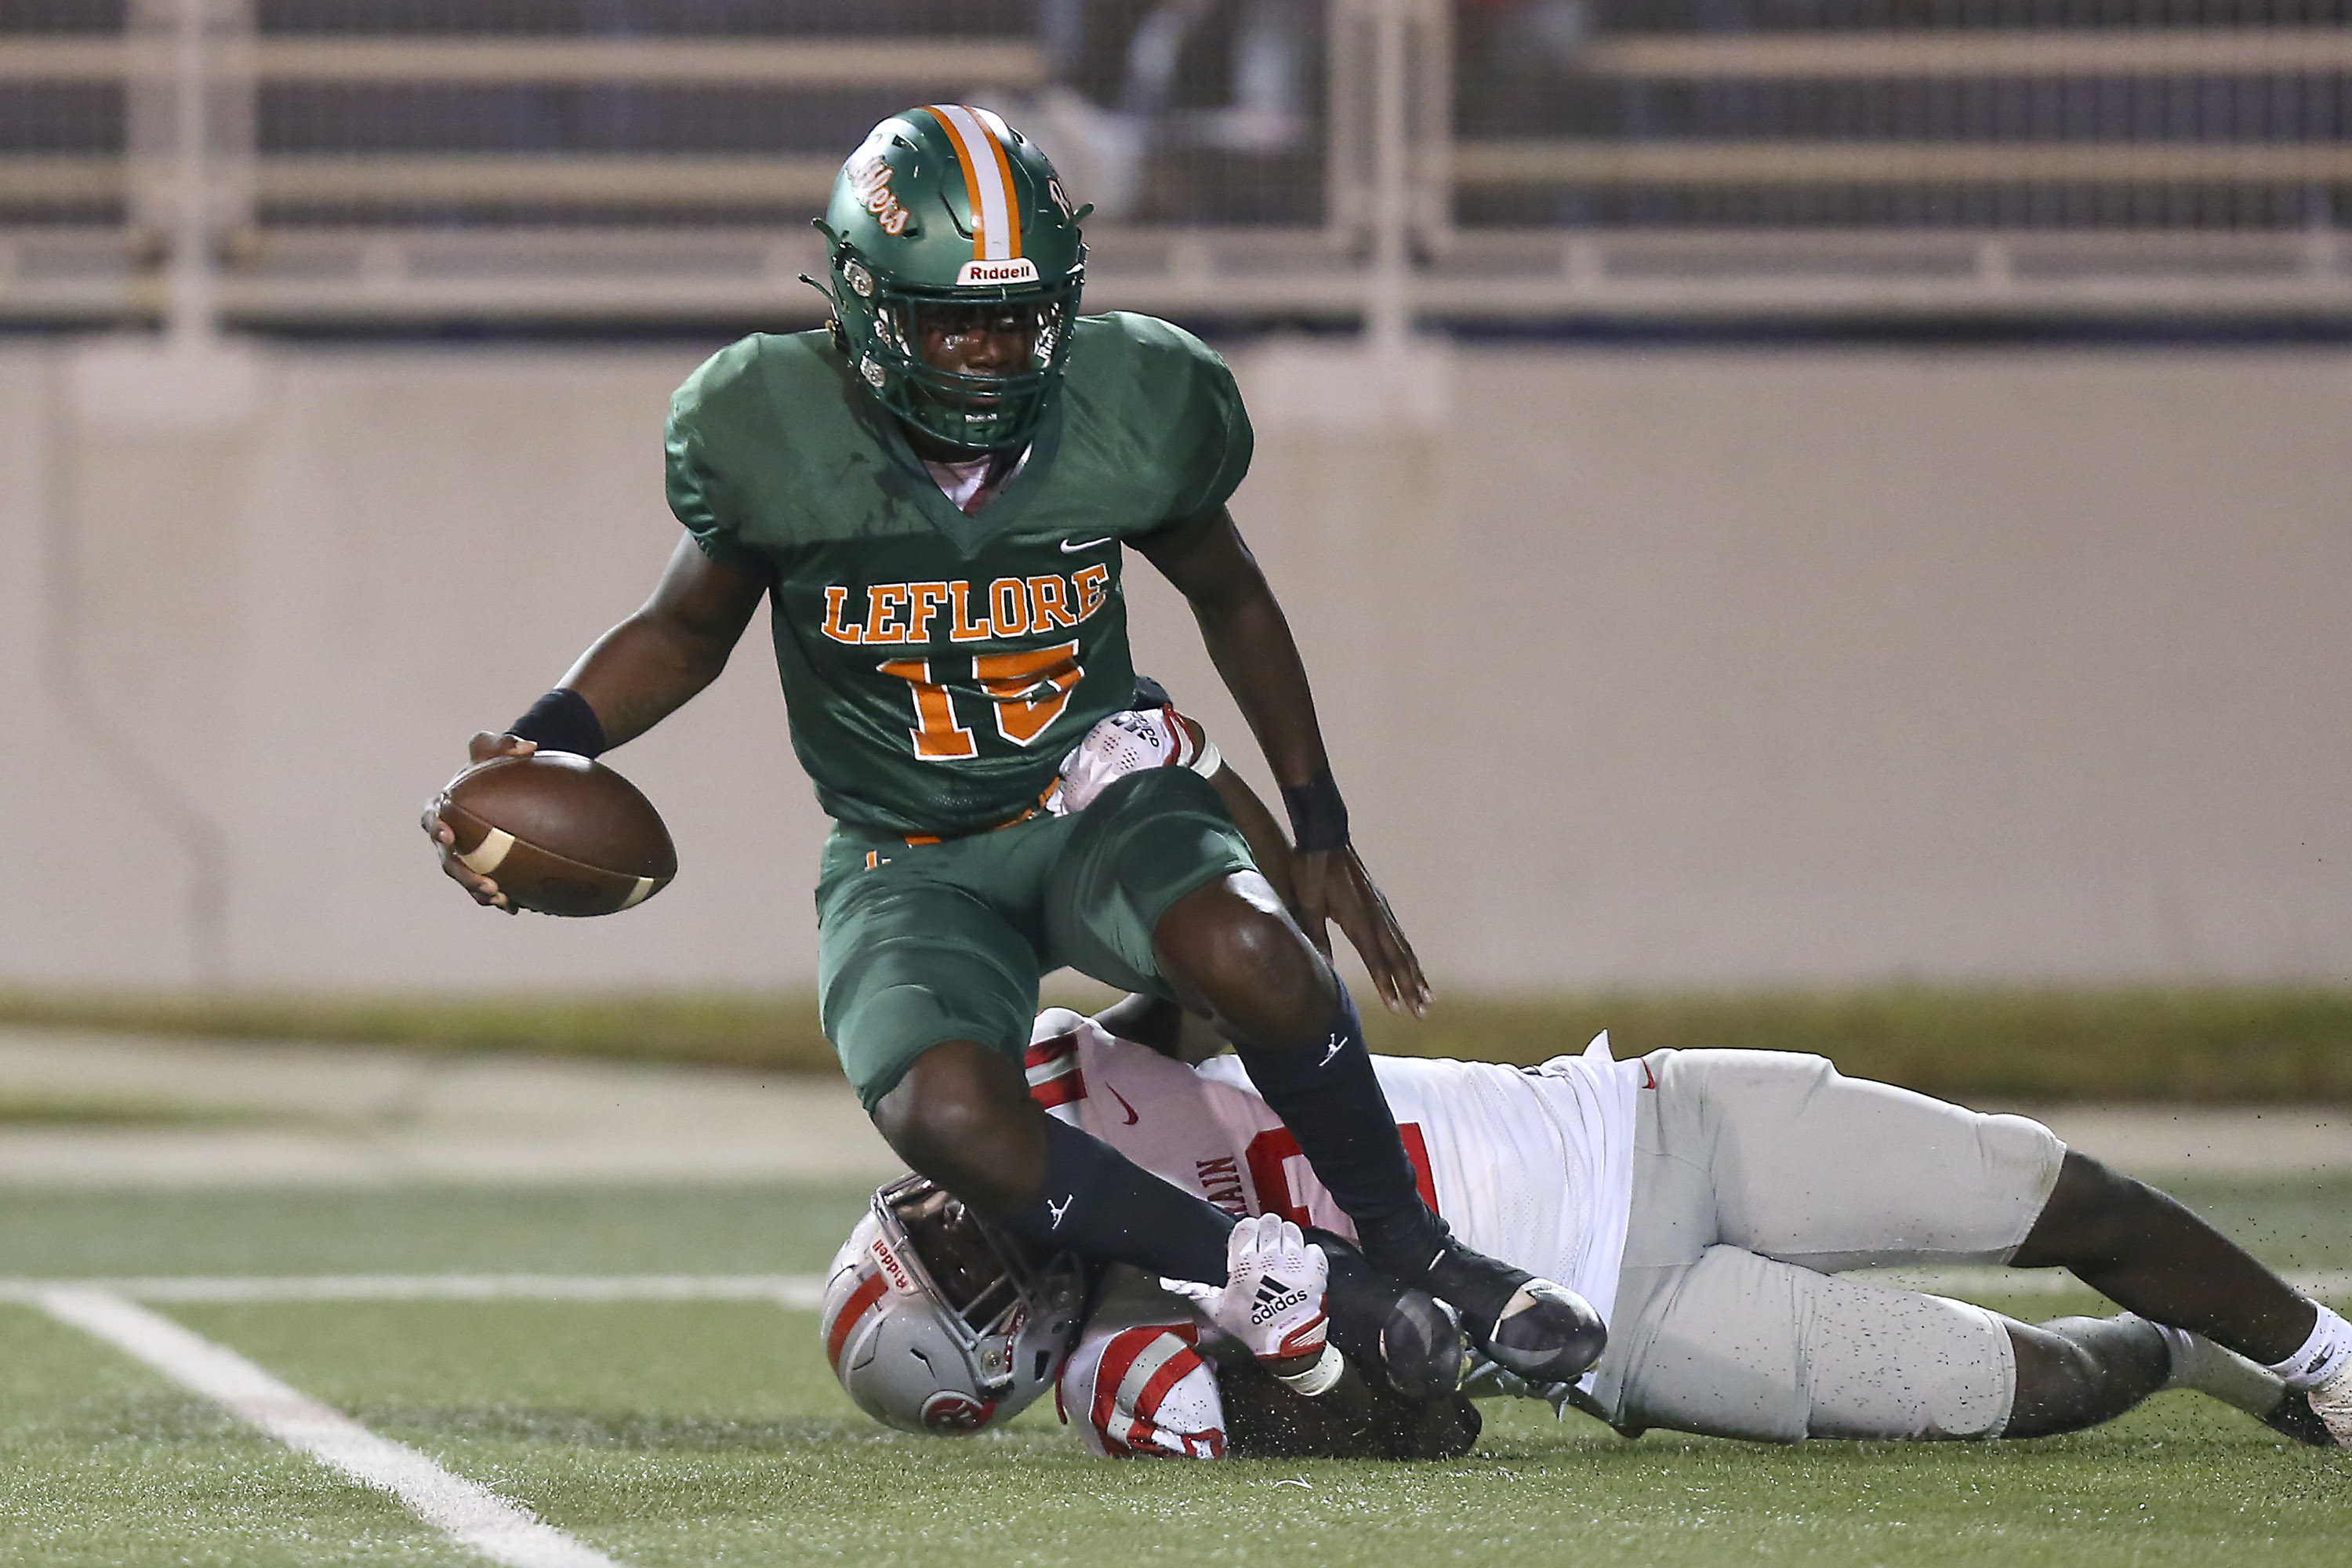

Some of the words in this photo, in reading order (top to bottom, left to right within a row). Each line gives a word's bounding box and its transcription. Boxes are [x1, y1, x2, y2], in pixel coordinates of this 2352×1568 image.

[971, 266, 1029, 280] Riddell
[821, 563, 1109, 644] LEFLORE
[876, 638, 1085, 760] 15
[873, 1240, 909, 1288] Riddell
[1251, 1290, 1308, 1325] adidas
